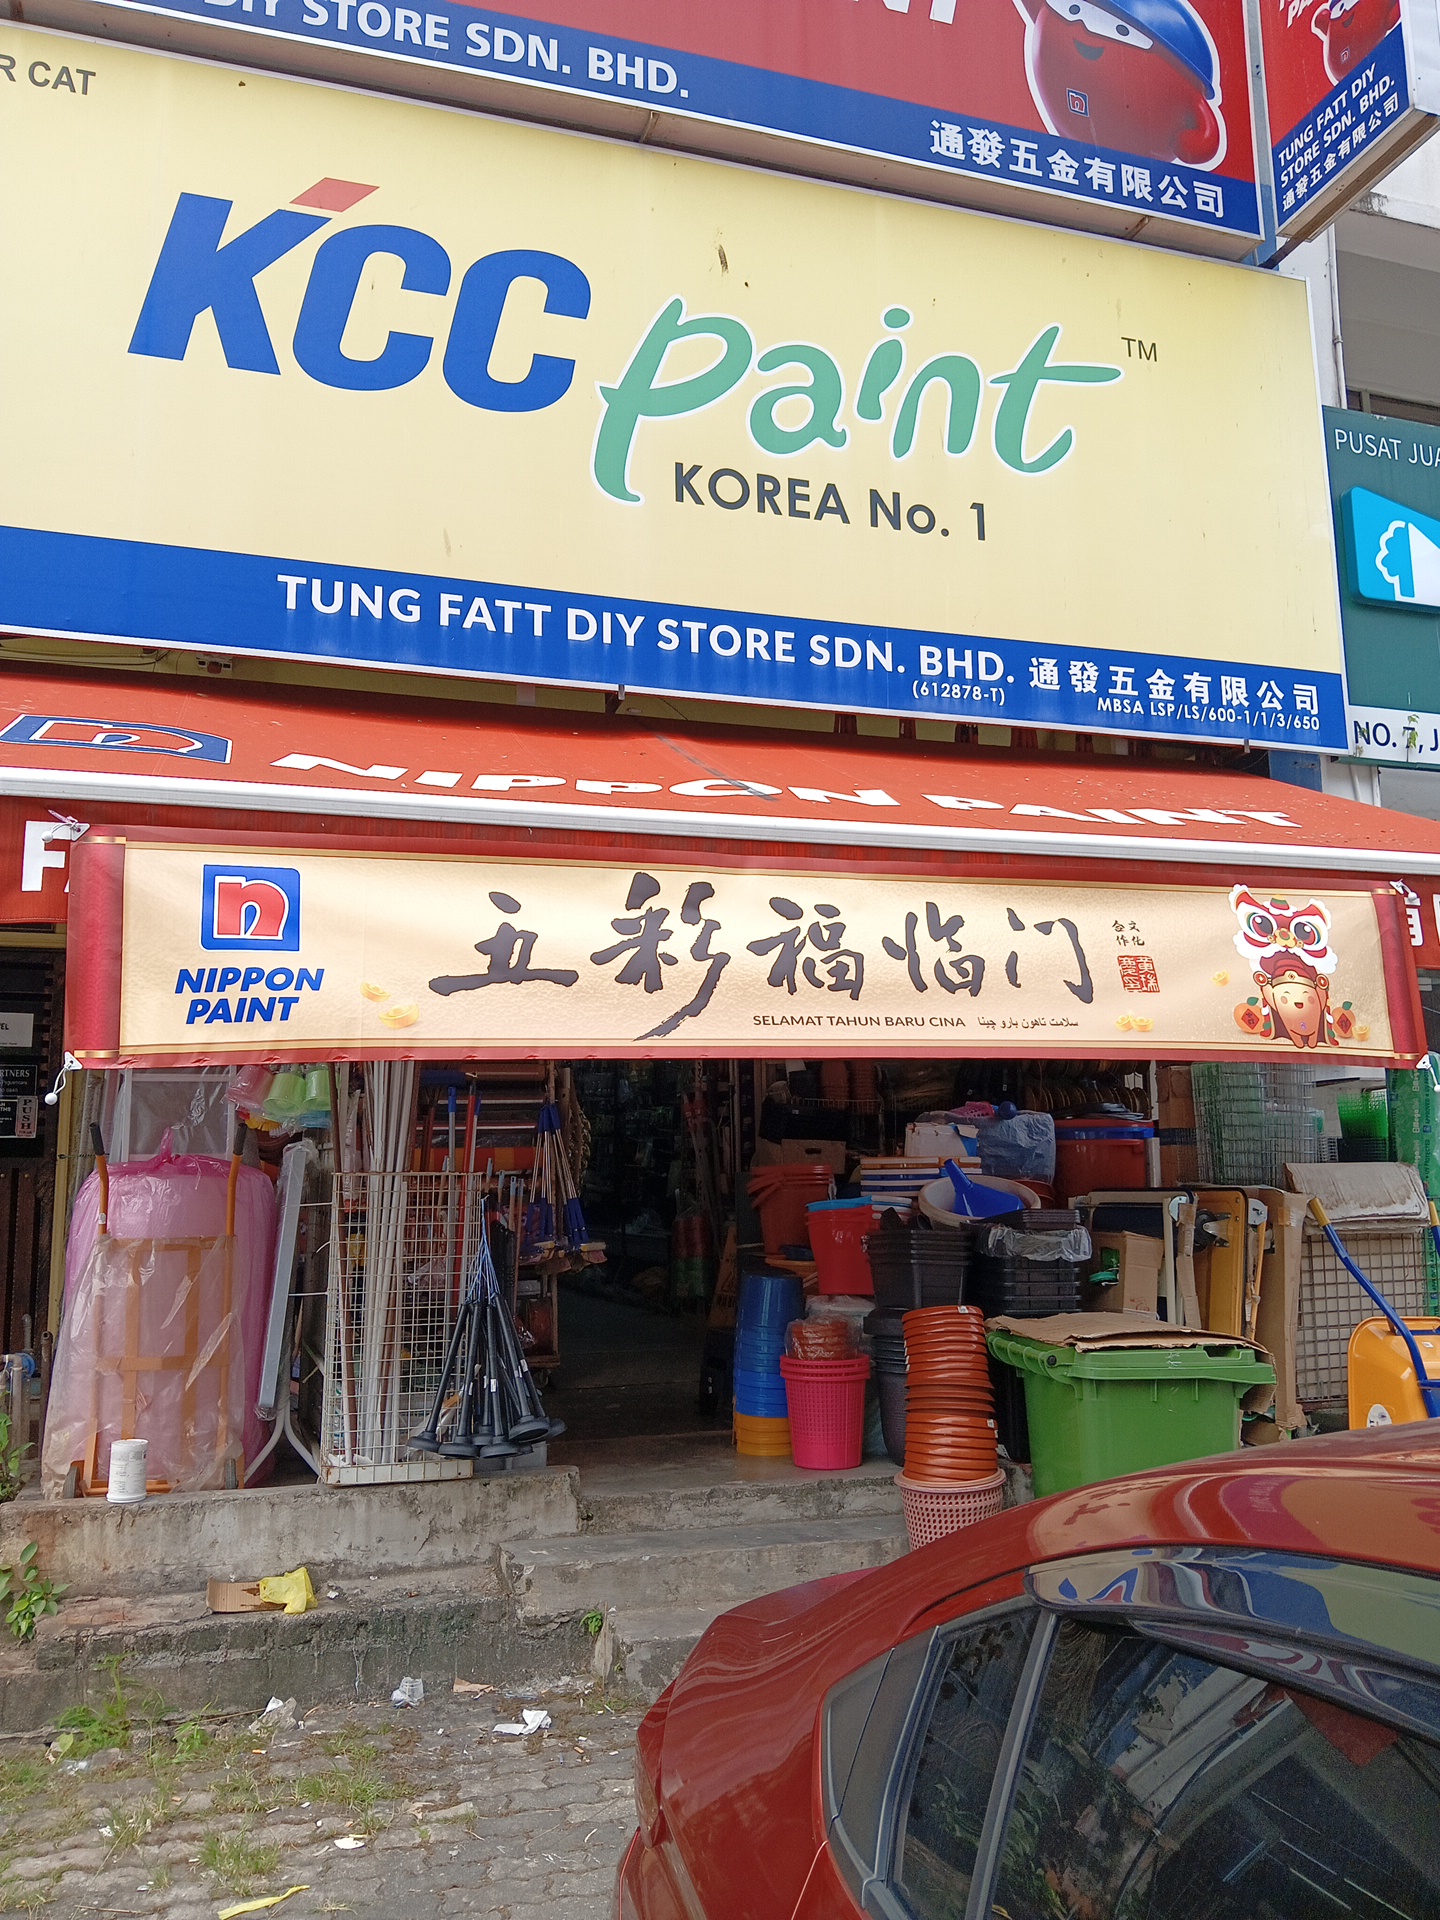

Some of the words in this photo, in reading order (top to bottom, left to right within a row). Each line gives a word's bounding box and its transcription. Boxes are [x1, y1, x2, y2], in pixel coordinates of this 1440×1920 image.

[28, 60, 96, 95] CAT
[302, 0, 450, 50] STORE
[466, 23, 571, 75] SDN.
[587, 46, 690, 98] BHD.
[1278, 124, 1315, 168] TUNG
[1316, 90, 1349, 132] FATT
[1351, 62, 1376, 99] DIY
[1281, 143, 1321, 188] STORE
[1323, 110, 1356, 148] SDN.
[1359, 75, 1395, 115] BHD.
[930, 119, 1225, 218] 通發五金有限公司
[1282, 91, 1400, 213] 通發五金有限公司
[127, 178, 591, 412] KCC
[594, 296, 1121, 503] paint
[1334, 428, 1402, 460] PUSAT
[674, 461, 850, 526] KOREA
[867, 488, 950, 539] No.
[968, 502, 988, 541] 1
[277, 573, 421, 623] TUNG
[439, 592, 552, 637] FATT
[567, 608, 645, 647] DIY
[656, 617, 796, 664] STORE
[808, 634, 906, 674] SDN.
[919, 645, 1015, 684] BHD.
[911, 679, 1006, 707] (612878-T)
[1028, 656, 1320, 715] 通發五金有限公司
[1096, 697, 1145, 715] MBSA
[1150, 703, 1320, 731] LSP/LS/600-1/1/3/650
[1354, 720, 1397, 748] NO.
[270, 752, 900, 808] NIPPON
[921, 793, 1303, 828] PAINT
[174, 966, 325, 994] NIPPON
[428, 871, 1093, 1042] 五彩福临门
[185, 996, 300, 1026] PAINT
[752, 1013, 824, 1027] SELAMAT
[827, 1014, 881, 1028] TAHUN
[884, 1014, 928, 1028] BARU
[929, 1014, 967, 1029] CINA
[20, 1098, 32, 1130] PUSH
